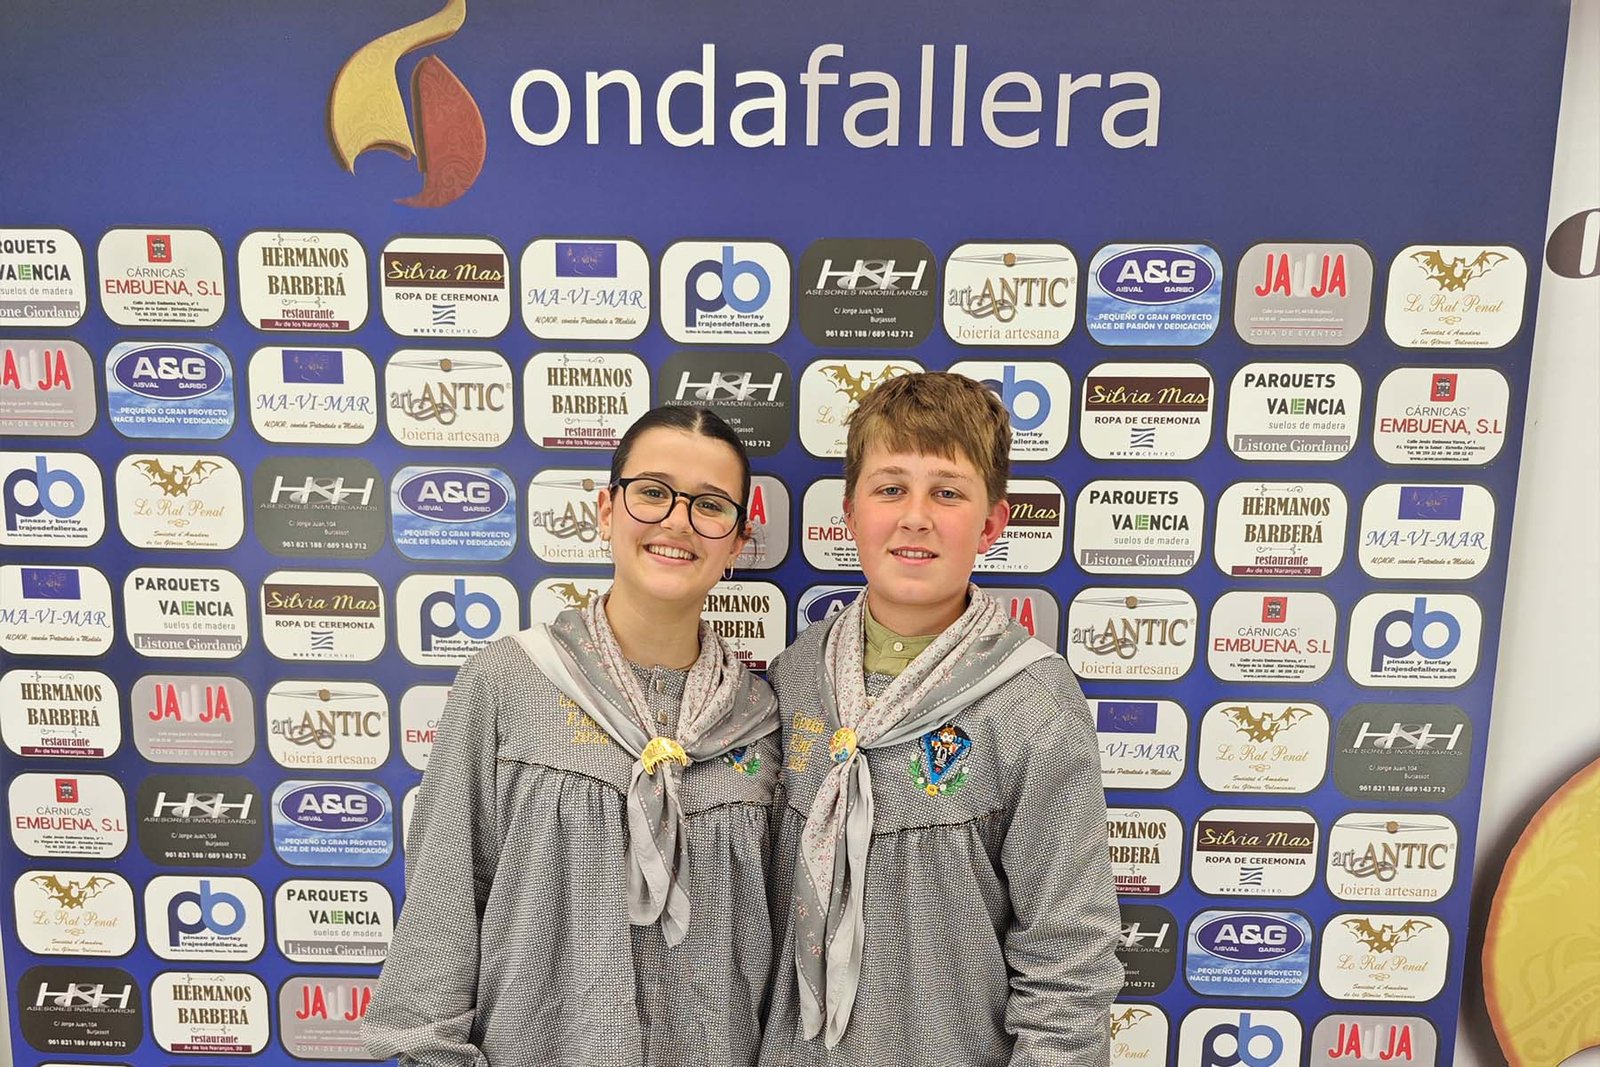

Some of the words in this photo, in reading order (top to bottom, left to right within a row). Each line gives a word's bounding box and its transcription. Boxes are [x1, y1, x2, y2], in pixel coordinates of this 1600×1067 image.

[510, 43, 1161, 147] ondafallera
[262, 247, 348, 268] HERMANOS
[126, 266, 185, 278] CÁRNICAS
[385, 261, 451, 280] Silvia
[454, 264, 505, 280] Mas
[1116, 260, 1196, 283] A&G
[104, 279, 192, 296] EMBUENA,
[196, 280, 222, 295] S.L
[268, 272, 346, 296] BARBERÁ
[395, 292, 422, 300] ROPA
[440, 294, 499, 302] CEREMONIA
[527, 287, 646, 309] MA-VI-MAR
[1404, 293, 1423, 312] Lo
[282, 309, 334, 319] restaurante
[956, 326, 1000, 339] Joieria
[1005, 327, 1059, 339] artesana
[130, 357, 207, 380] A&G
[546, 367, 632, 388] HERMANOS
[1244, 373, 1336, 388] PARQUETS
[1088, 385, 1154, 403] Silvia
[1157, 387, 1209, 403] Mas
[256, 392, 374, 414] MA-VI-MAR
[551, 392, 629, 415] BARBERÁ
[1406, 405, 1467, 416] CÁRNICAS
[1094, 416, 1122, 424] ROPA
[1268, 421, 1296, 429] suelos
[1299, 421, 1310, 429] de
[1312, 422, 1346, 430] madera
[1380, 418, 1471, 435] EMBUENA,
[1476, 419, 1502, 434] S.L
[400, 428, 442, 441] Joieria
[447, 429, 500, 441] artesana
[564, 427, 616, 437] restaurante
[1238, 438, 1287, 452] Listone
[416, 481, 491, 503] A&G
[1089, 490, 1179, 504] PARQUETS
[133, 498, 152, 515] Lo
[1010, 503, 1060, 518] Mas
[1241, 496, 1331, 517] HERMANOS
[1244, 521, 1325, 544] BARBERÁ
[1365, 529, 1489, 550] MA-VI-MAR
[1085, 552, 1133, 566] Listone
[1254, 556, 1308, 565] restaurante
[134, 577, 220, 591] PARQUETS
[265, 592, 328, 609] Silvia
[331, 594, 380, 610] Mas
[1238, 626, 1297, 637] CÁRNICAS
[138, 636, 184, 649] Listone
[1214, 638, 1301, 654] EMBUENA,
[1306, 639, 1331, 653] S.L
[1079, 662, 1121, 674] Joieria
[1126, 663, 1179, 674] artesana
[21, 683, 102, 702] HERMANOS
[27, 706, 100, 726] BARBERÁ
[41, 738, 90, 746] restaurante
[281, 752, 322, 763] Joieria
[326, 753, 377, 764] artesana
[1216, 744, 1235, 760] Lo
[36, 806, 91, 816] CÁRNICAS
[296, 794, 368, 814] A&G
[15, 816, 97, 832] EMBUENA,
[1199, 829, 1262, 845] Silvia
[1265, 832, 1314, 846] Mas
[286, 889, 369, 902] PARQUETS
[1385, 886, 1438, 897] artesana
[31, 909, 50, 925] Lo
[1214, 924, 1287, 944] A&G
[288, 943, 333, 955] Listone
[1336, 954, 1355, 970] Lo
[172, 985, 251, 1002] HERMANOS
[178, 1006, 249, 1025] BARBERÁ
[191, 1035, 238, 1043] restaurante
